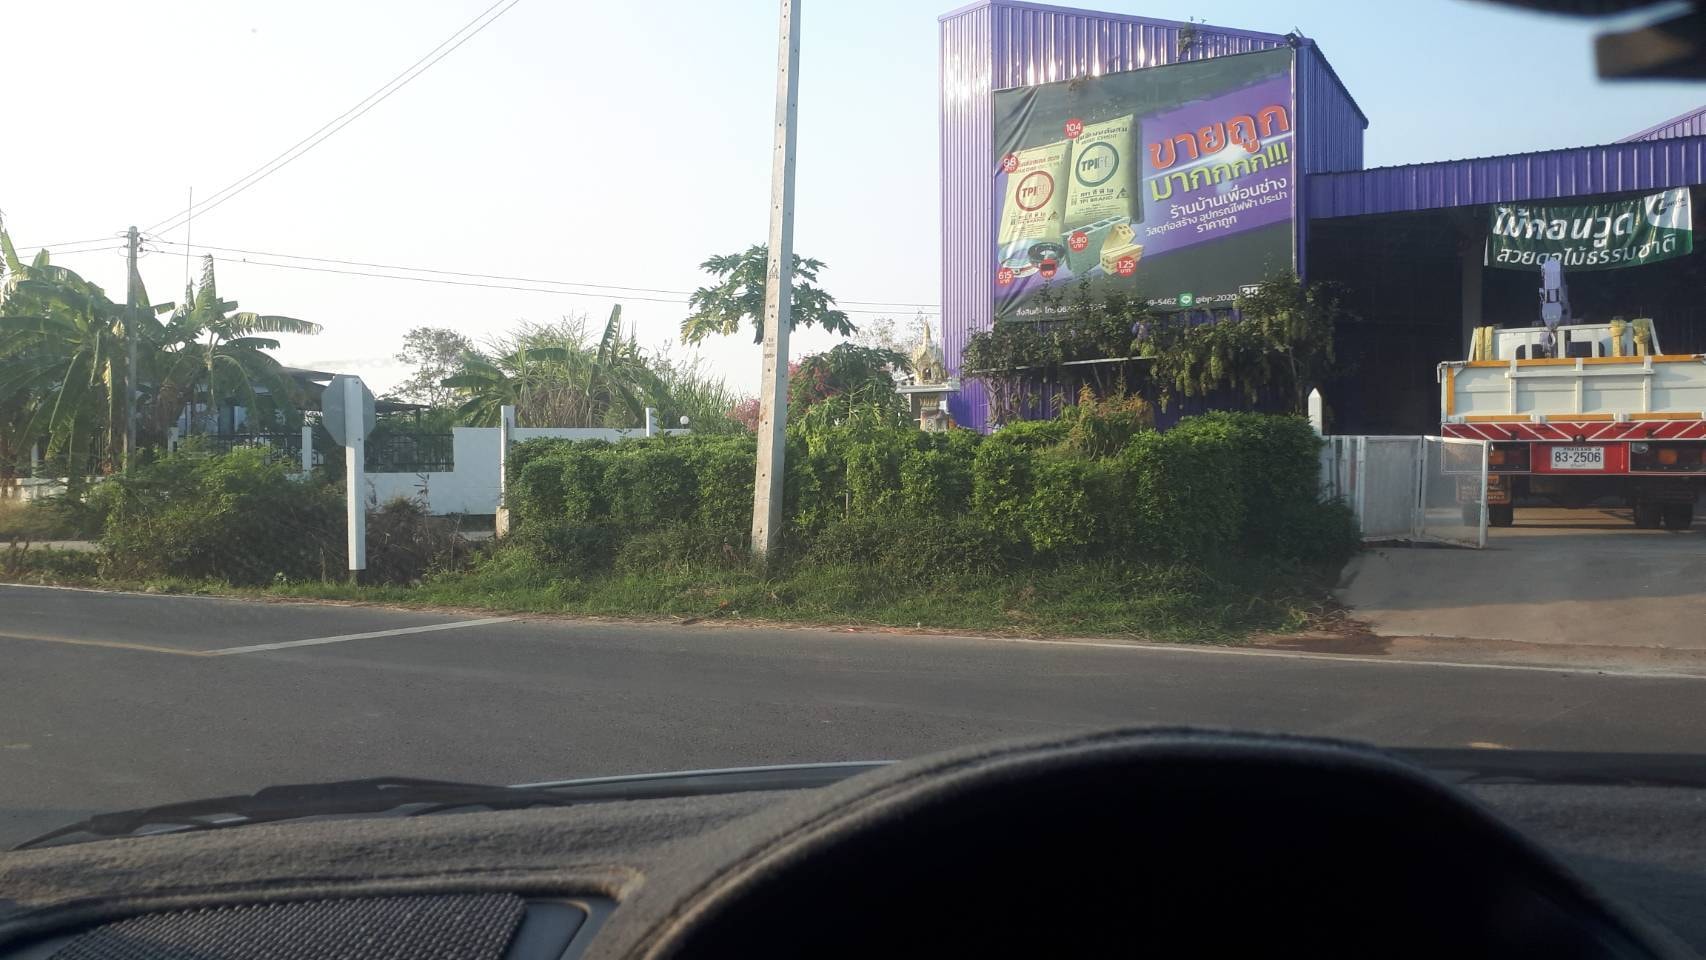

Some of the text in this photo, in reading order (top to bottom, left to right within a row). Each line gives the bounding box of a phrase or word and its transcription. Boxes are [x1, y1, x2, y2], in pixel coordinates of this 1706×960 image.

[1066, 122, 1081, 132] 104
[1148, 105, 1289, 169] ขายถูก
[1150, 142, 1289, 201] มากกกก!!!
[1145, 216, 1198, 237] วัสดุก่อสร้าง
[1260, 190, 1287, 206] ประปา
[1170, 177, 1287, 219] ร้านบ้านเพื่อนช่าง
[1196, 214, 1238, 233] ราคาถูก
[1496, 233, 1676, 266] สวยดไม้ธรรมชาติ
[1554, 451, 1601, 463] 83-2506
